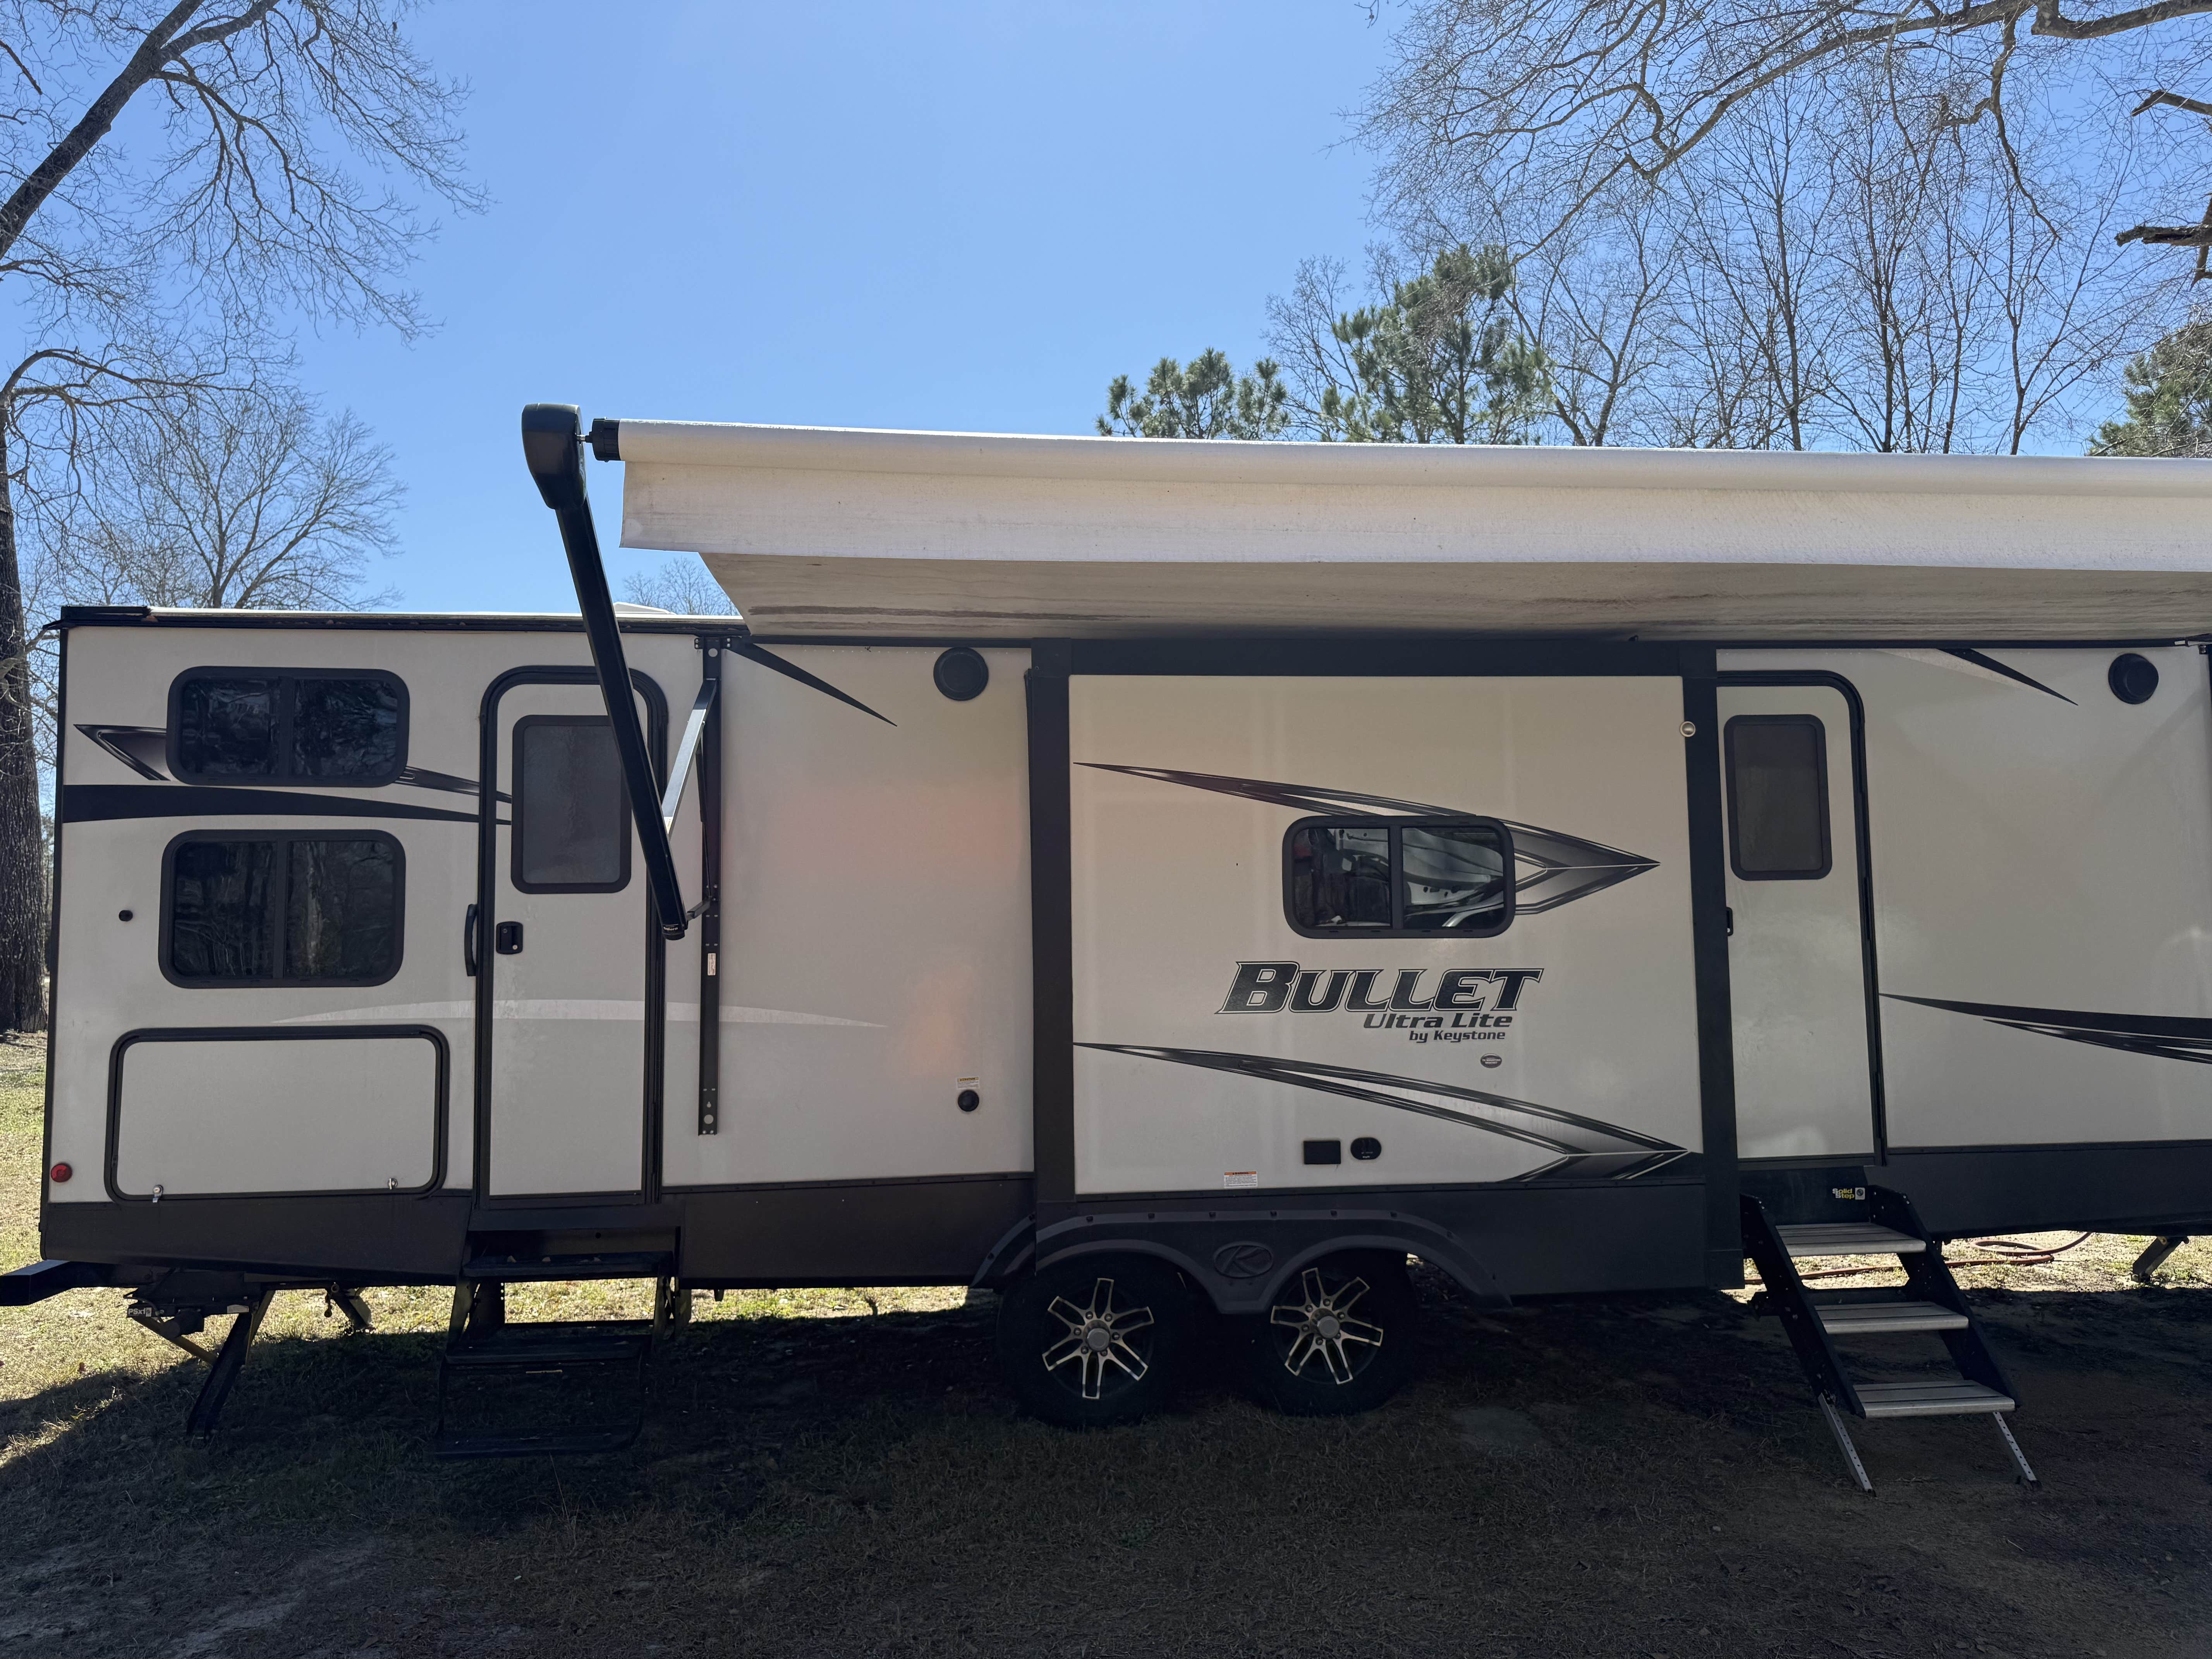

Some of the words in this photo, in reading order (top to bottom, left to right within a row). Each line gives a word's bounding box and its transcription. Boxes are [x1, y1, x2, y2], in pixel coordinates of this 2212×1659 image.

[1214, 961, 1544, 1014] BULLET
[1363, 1013, 1444, 1029] Ultra
[1451, 1012, 1513, 1028] Lite
[1409, 1030, 1429, 1044] by
[1433, 1030, 1506, 1043] Keystone
